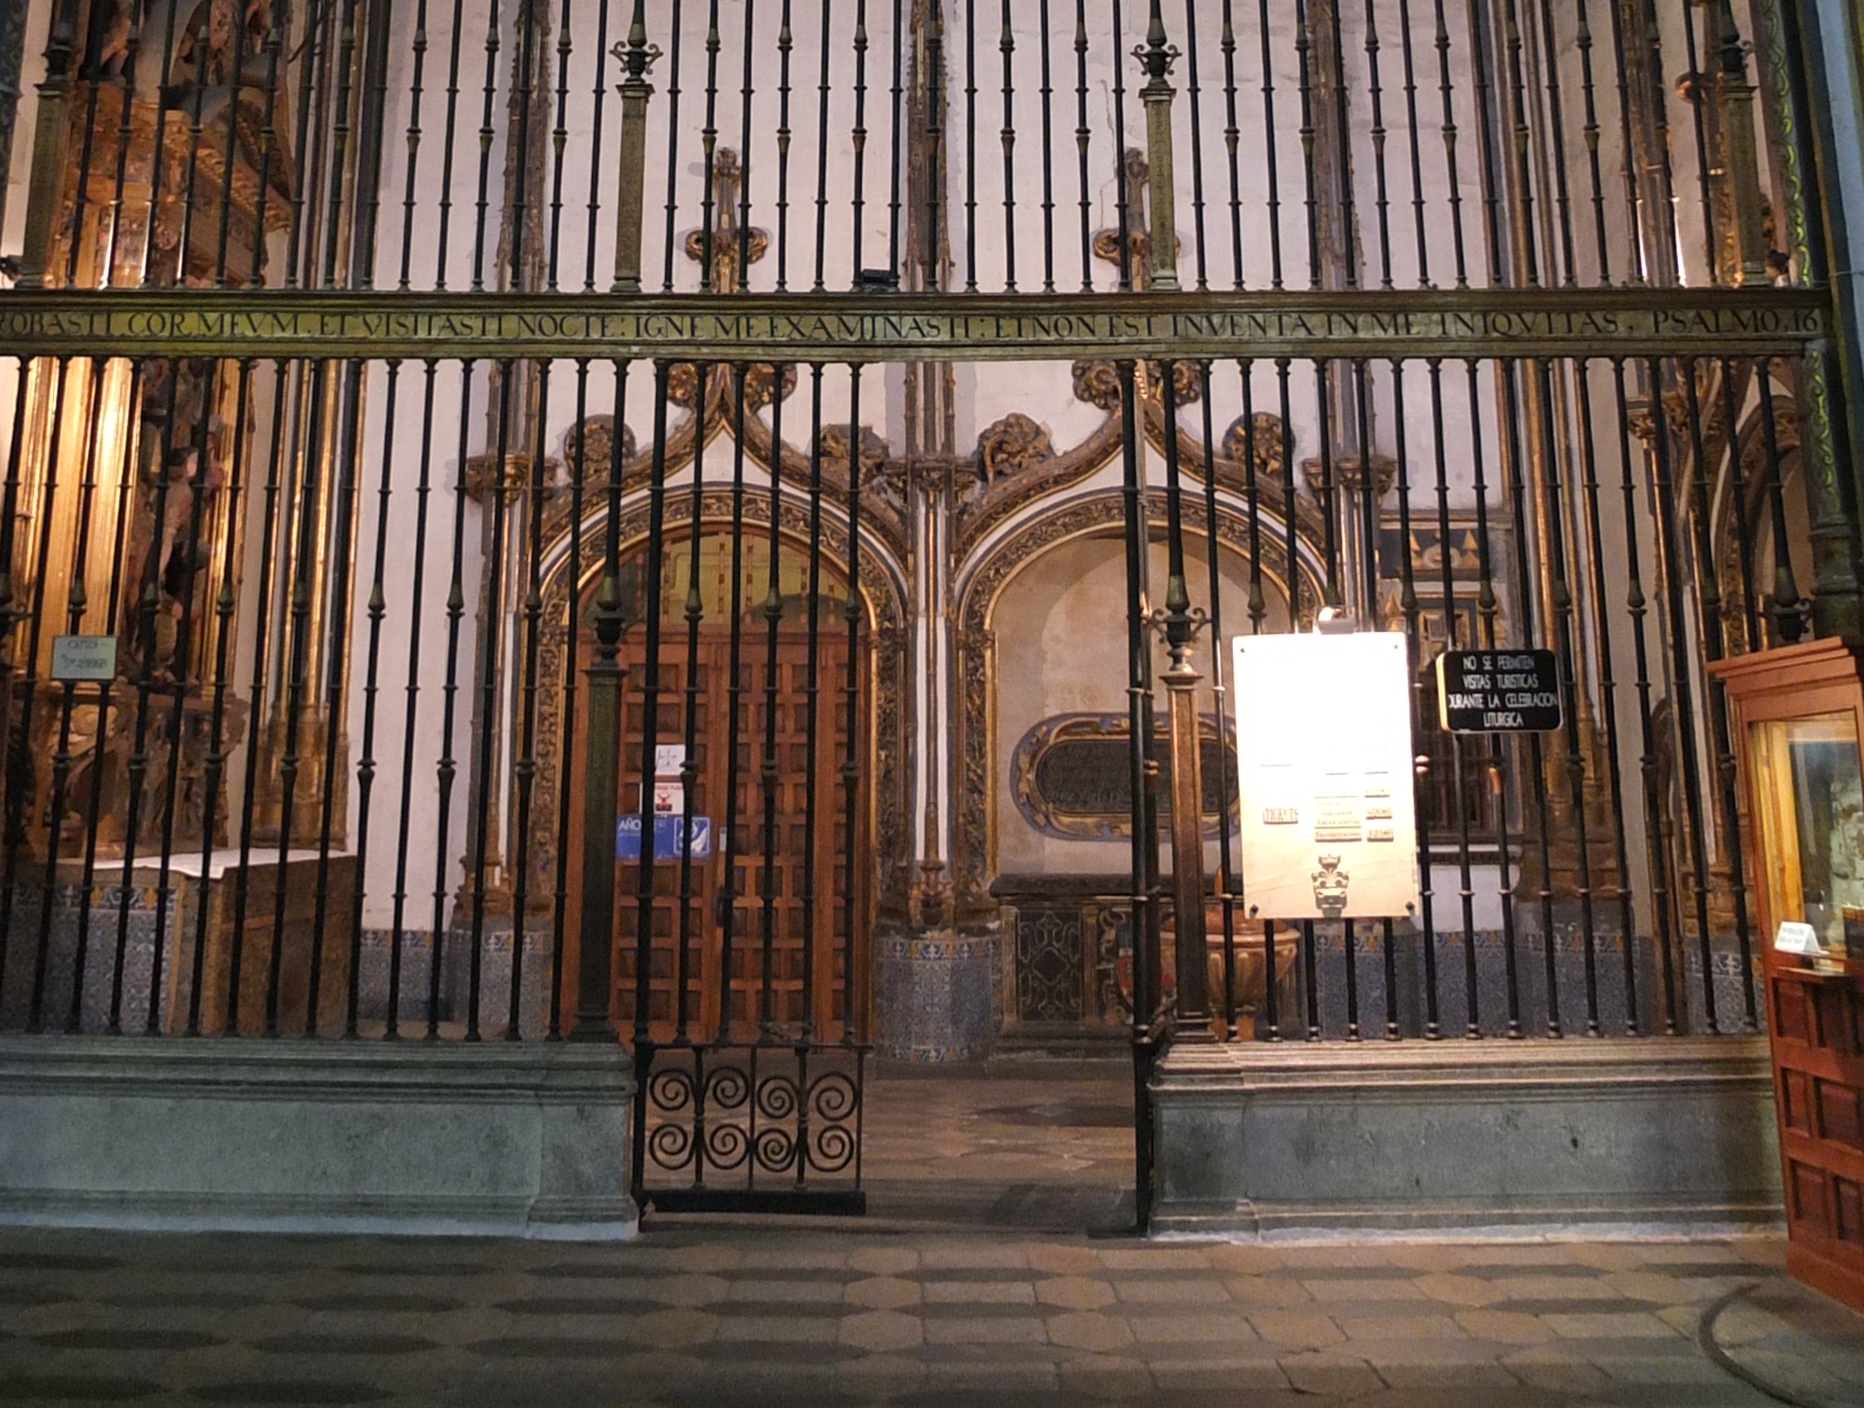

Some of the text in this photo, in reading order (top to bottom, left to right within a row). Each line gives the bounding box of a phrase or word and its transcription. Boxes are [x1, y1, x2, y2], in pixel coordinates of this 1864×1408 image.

[127, 311, 185, 337] COR
[319, 312, 352, 336] ET
[361, 312, 503, 337] VISITASTI
[635, 314, 704, 338] IGNE
[714, 314, 761, 339] ME
[995, 314, 1027, 339] ET
[1032, 315, 1096, 339] NON
[1107, 313, 1158, 338] EST
[1172, 312, 1315, 338] INVENTA
[1324, 312, 1359, 337] IN
[1370, 311, 1420, 336] ME
[1794, 307, 1819, 332] 16
[1462, 655, 1535, 670] NO SE PERMITEN
[1448, 693, 1485, 709] DURANTE
[1488, 693, 1501, 708] LA
[618, 817, 642, 831] AÑO
